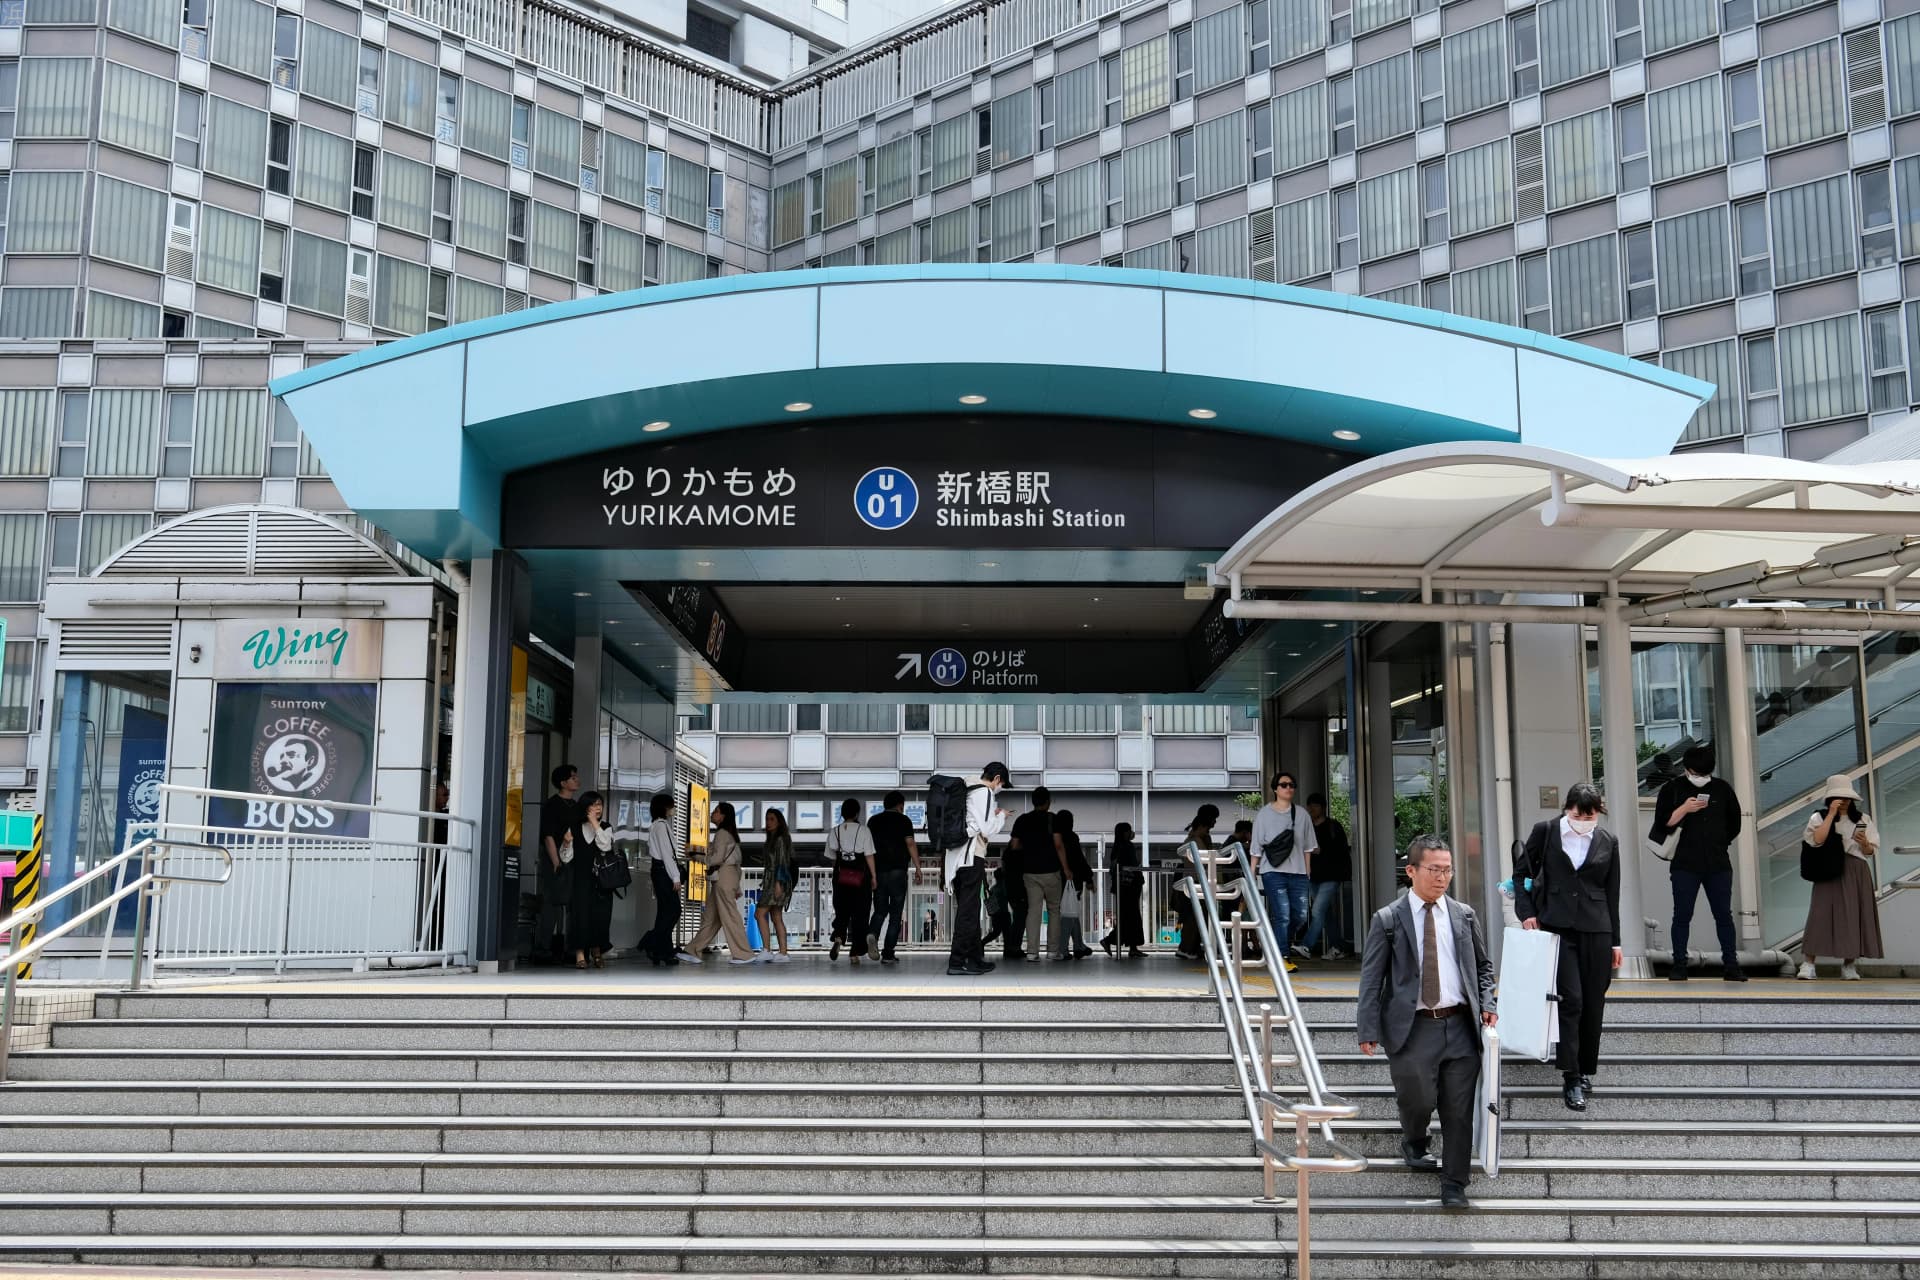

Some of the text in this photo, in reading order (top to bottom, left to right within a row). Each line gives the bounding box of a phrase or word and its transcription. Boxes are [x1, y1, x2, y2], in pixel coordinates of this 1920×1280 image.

[602, 466, 797, 497] ゆりかもめ
[878, 474, 895, 491] U
[936, 470, 1052, 505] 新橋駅
[602, 504, 797, 527] YURIKAMOME
[866, 493, 903, 519] 01
[936, 508, 1126, 528] Shimbashi Station
[242, 626, 349, 669] Wing
[942, 652, 953, 663] U
[972, 649, 1026, 668] のりば
[936, 664, 958, 680] 01
[972, 669, 1038, 686] Platform
[263, 716, 331, 741] COFFEE
[244, 800, 336, 829] BOSS
